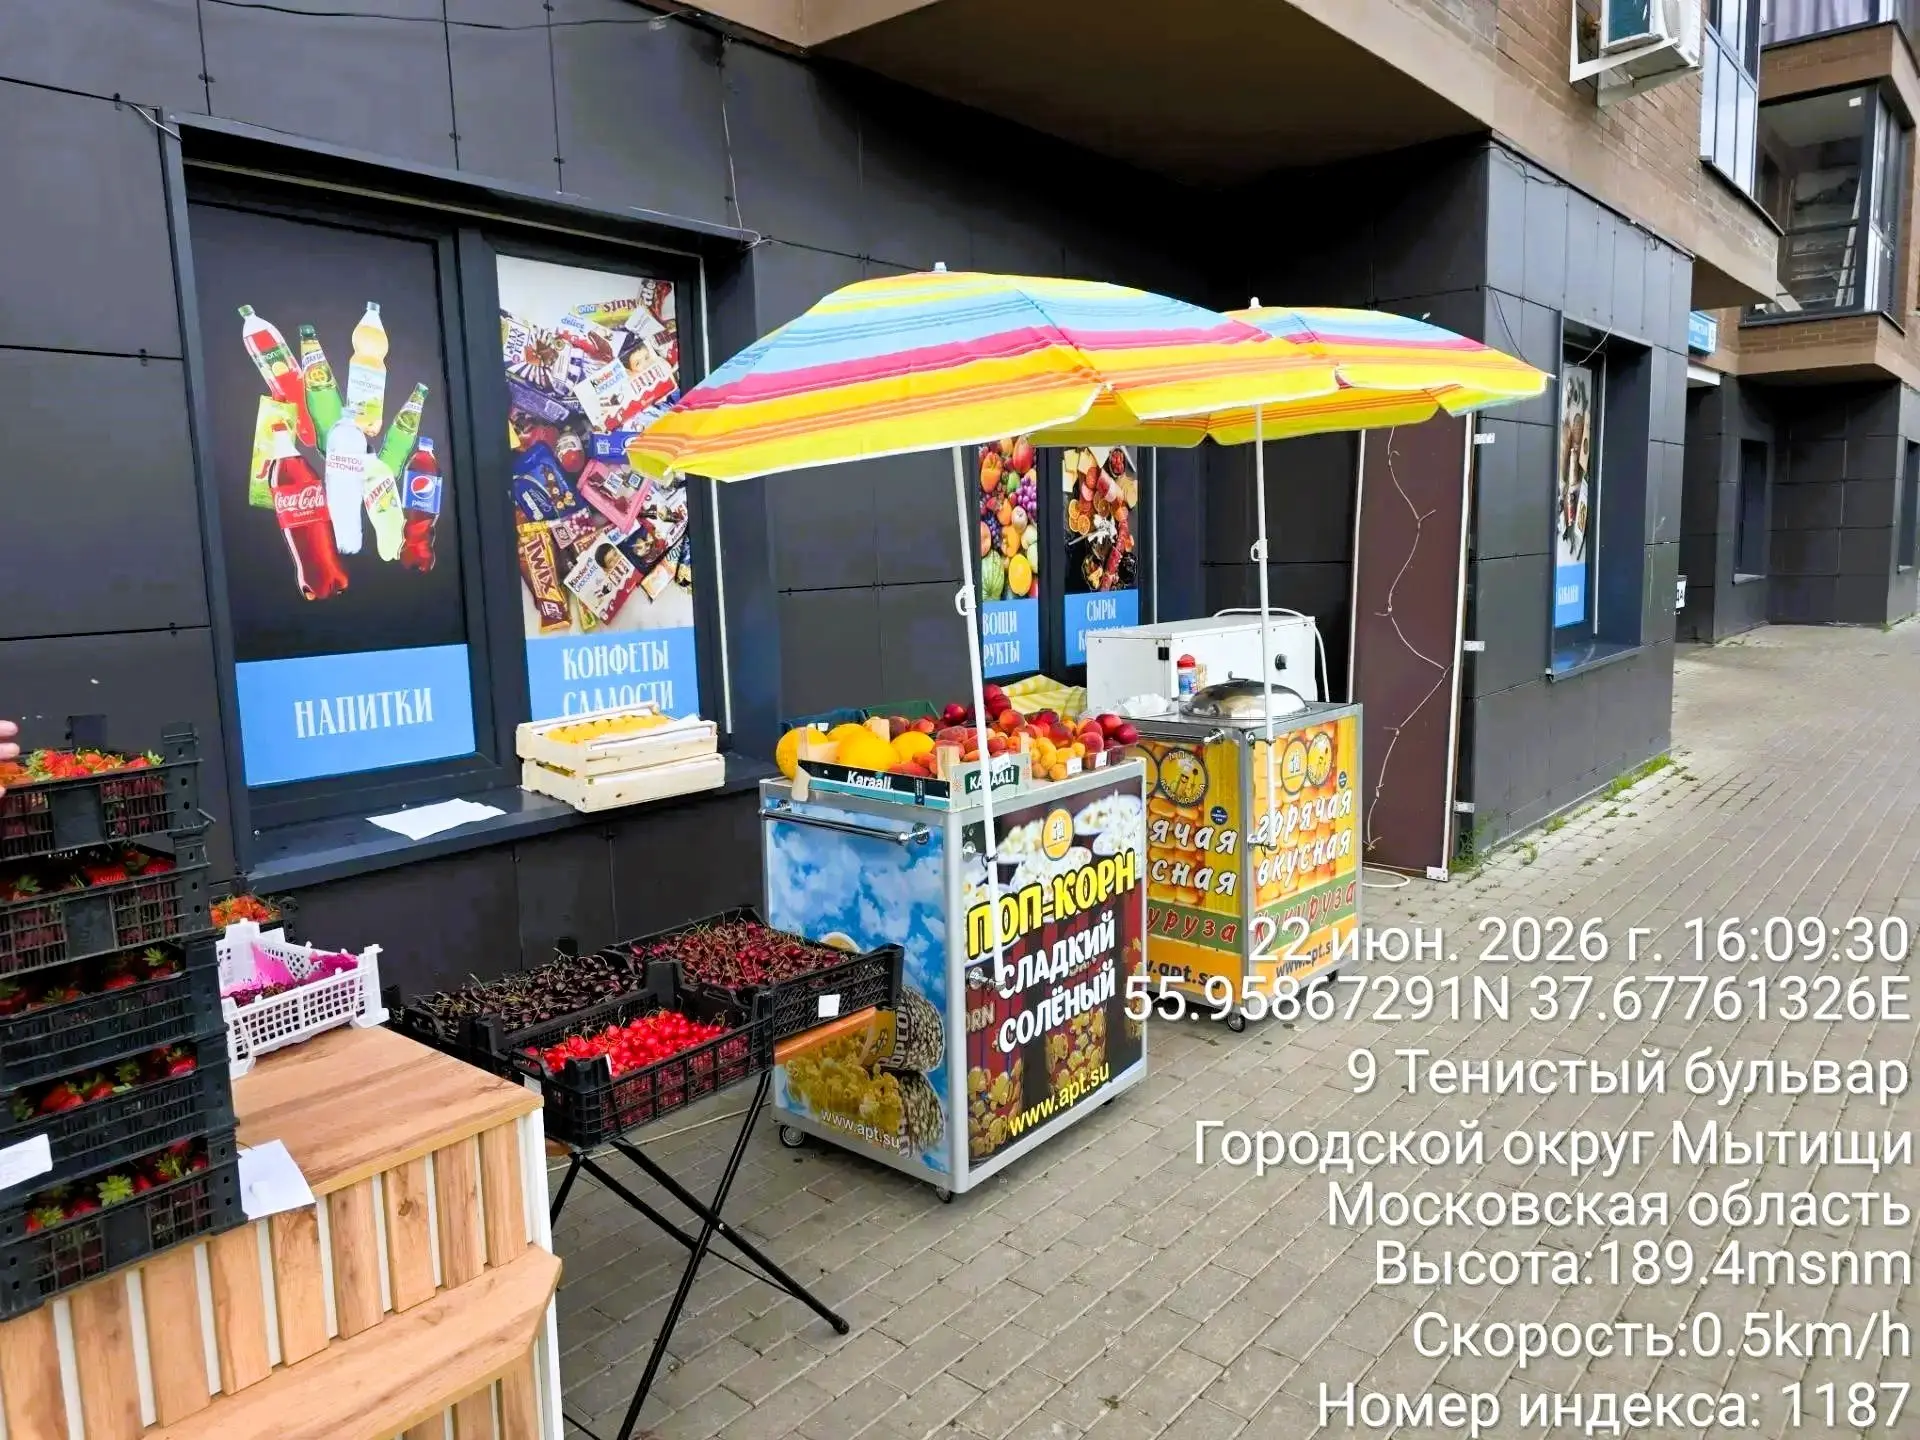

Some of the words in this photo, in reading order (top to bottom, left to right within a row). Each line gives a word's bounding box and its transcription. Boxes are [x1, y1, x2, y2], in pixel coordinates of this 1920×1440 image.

[983, 611, 1017, 635] ВОЩИ
[1087, 598, 1116, 622] СЫРЫ
[562, 640, 669, 680] КОНФЕТЫ
[983, 640, 1020, 668] РУКТЫ
[294, 687, 434, 739] НАПИТКИ
[999, 959, 1115, 1052] СОЛЁНЫЙ
[1010, 1063, 1109, 1137] www.apt.su
[822, 1111, 900, 1149] www.apt.su
